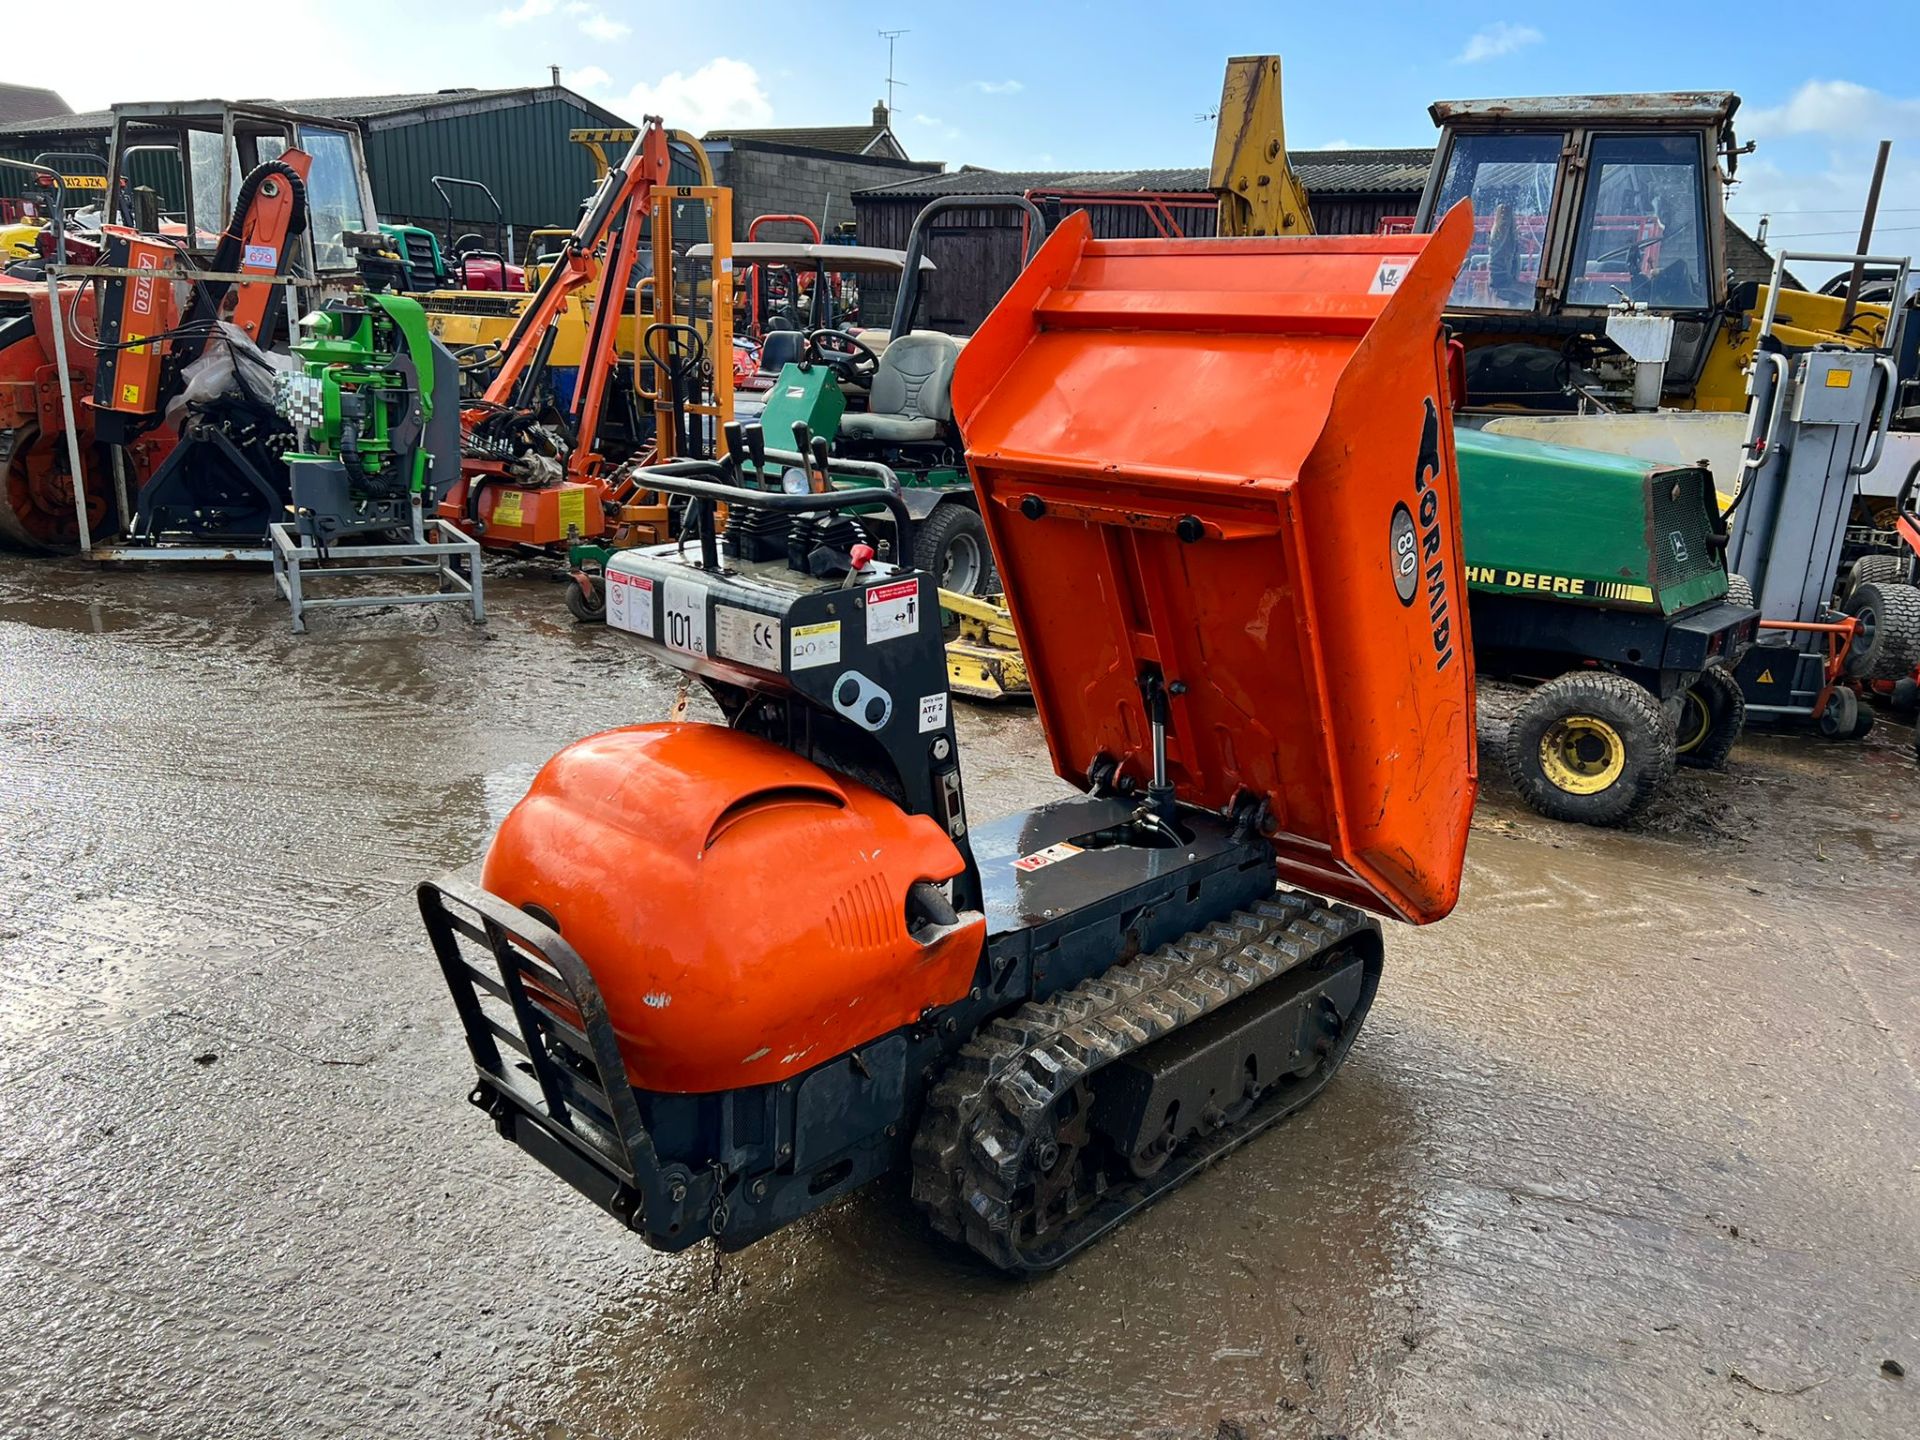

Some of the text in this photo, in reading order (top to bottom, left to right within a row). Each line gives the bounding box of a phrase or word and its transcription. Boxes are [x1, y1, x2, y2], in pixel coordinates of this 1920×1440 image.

[65, 177, 102, 188] X12 JZK
[250, 252, 272, 263] 679
[1415, 396, 1453, 672] CORMIDI
[1397, 531, 1416, 577] 80
[1465, 566, 1585, 595] HN DEERE
[667, 610, 692, 650] 101
[753, 622, 773, 650] CE
[922, 703, 943, 714] ATF 2
[927, 715, 937, 723] Oil
